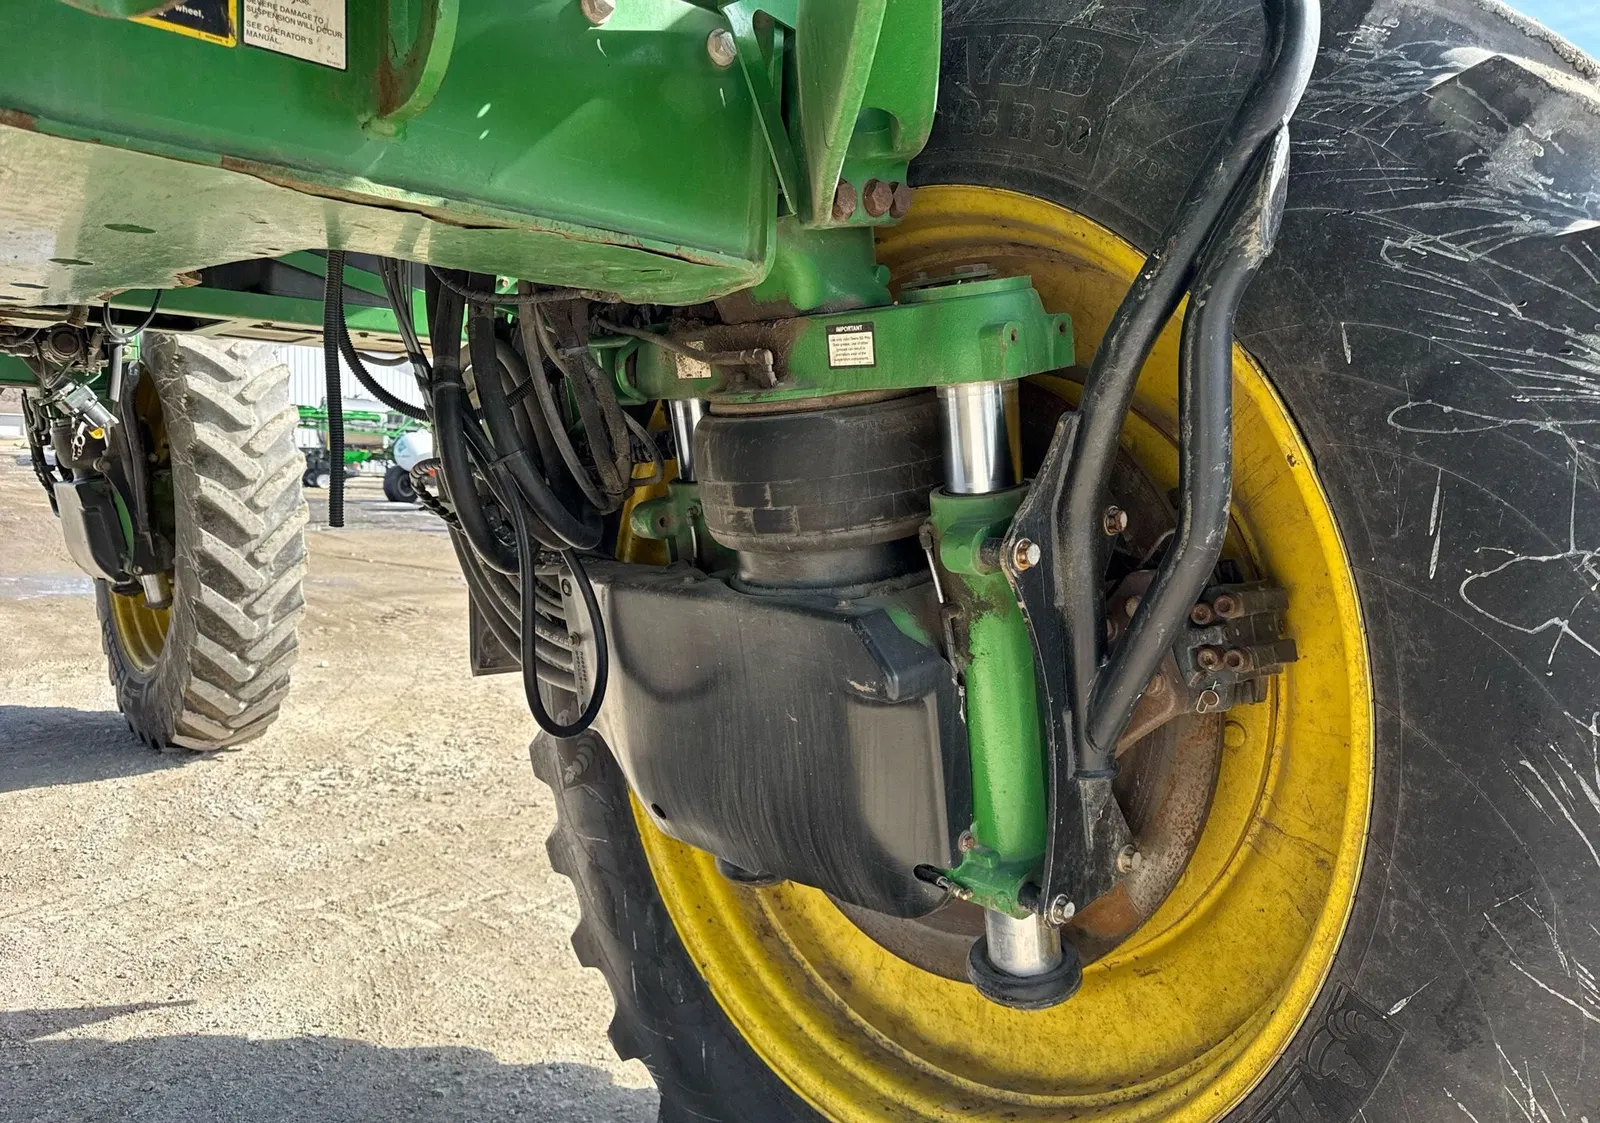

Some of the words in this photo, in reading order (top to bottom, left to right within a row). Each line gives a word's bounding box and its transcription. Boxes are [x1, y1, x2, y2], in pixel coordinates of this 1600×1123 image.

[175, 4, 205, 19] wheel,
[246, 5, 296, 25] SUSPENSION
[296, 19, 315, 31] WILL
[280, 5, 314, 21] DAMAGE
[314, 15, 324, 25] TO
[246, 20, 262, 30] SEE
[263, 25, 314, 45] OPERATOR'S
[835, 324, 863, 333] IMPORTANT
